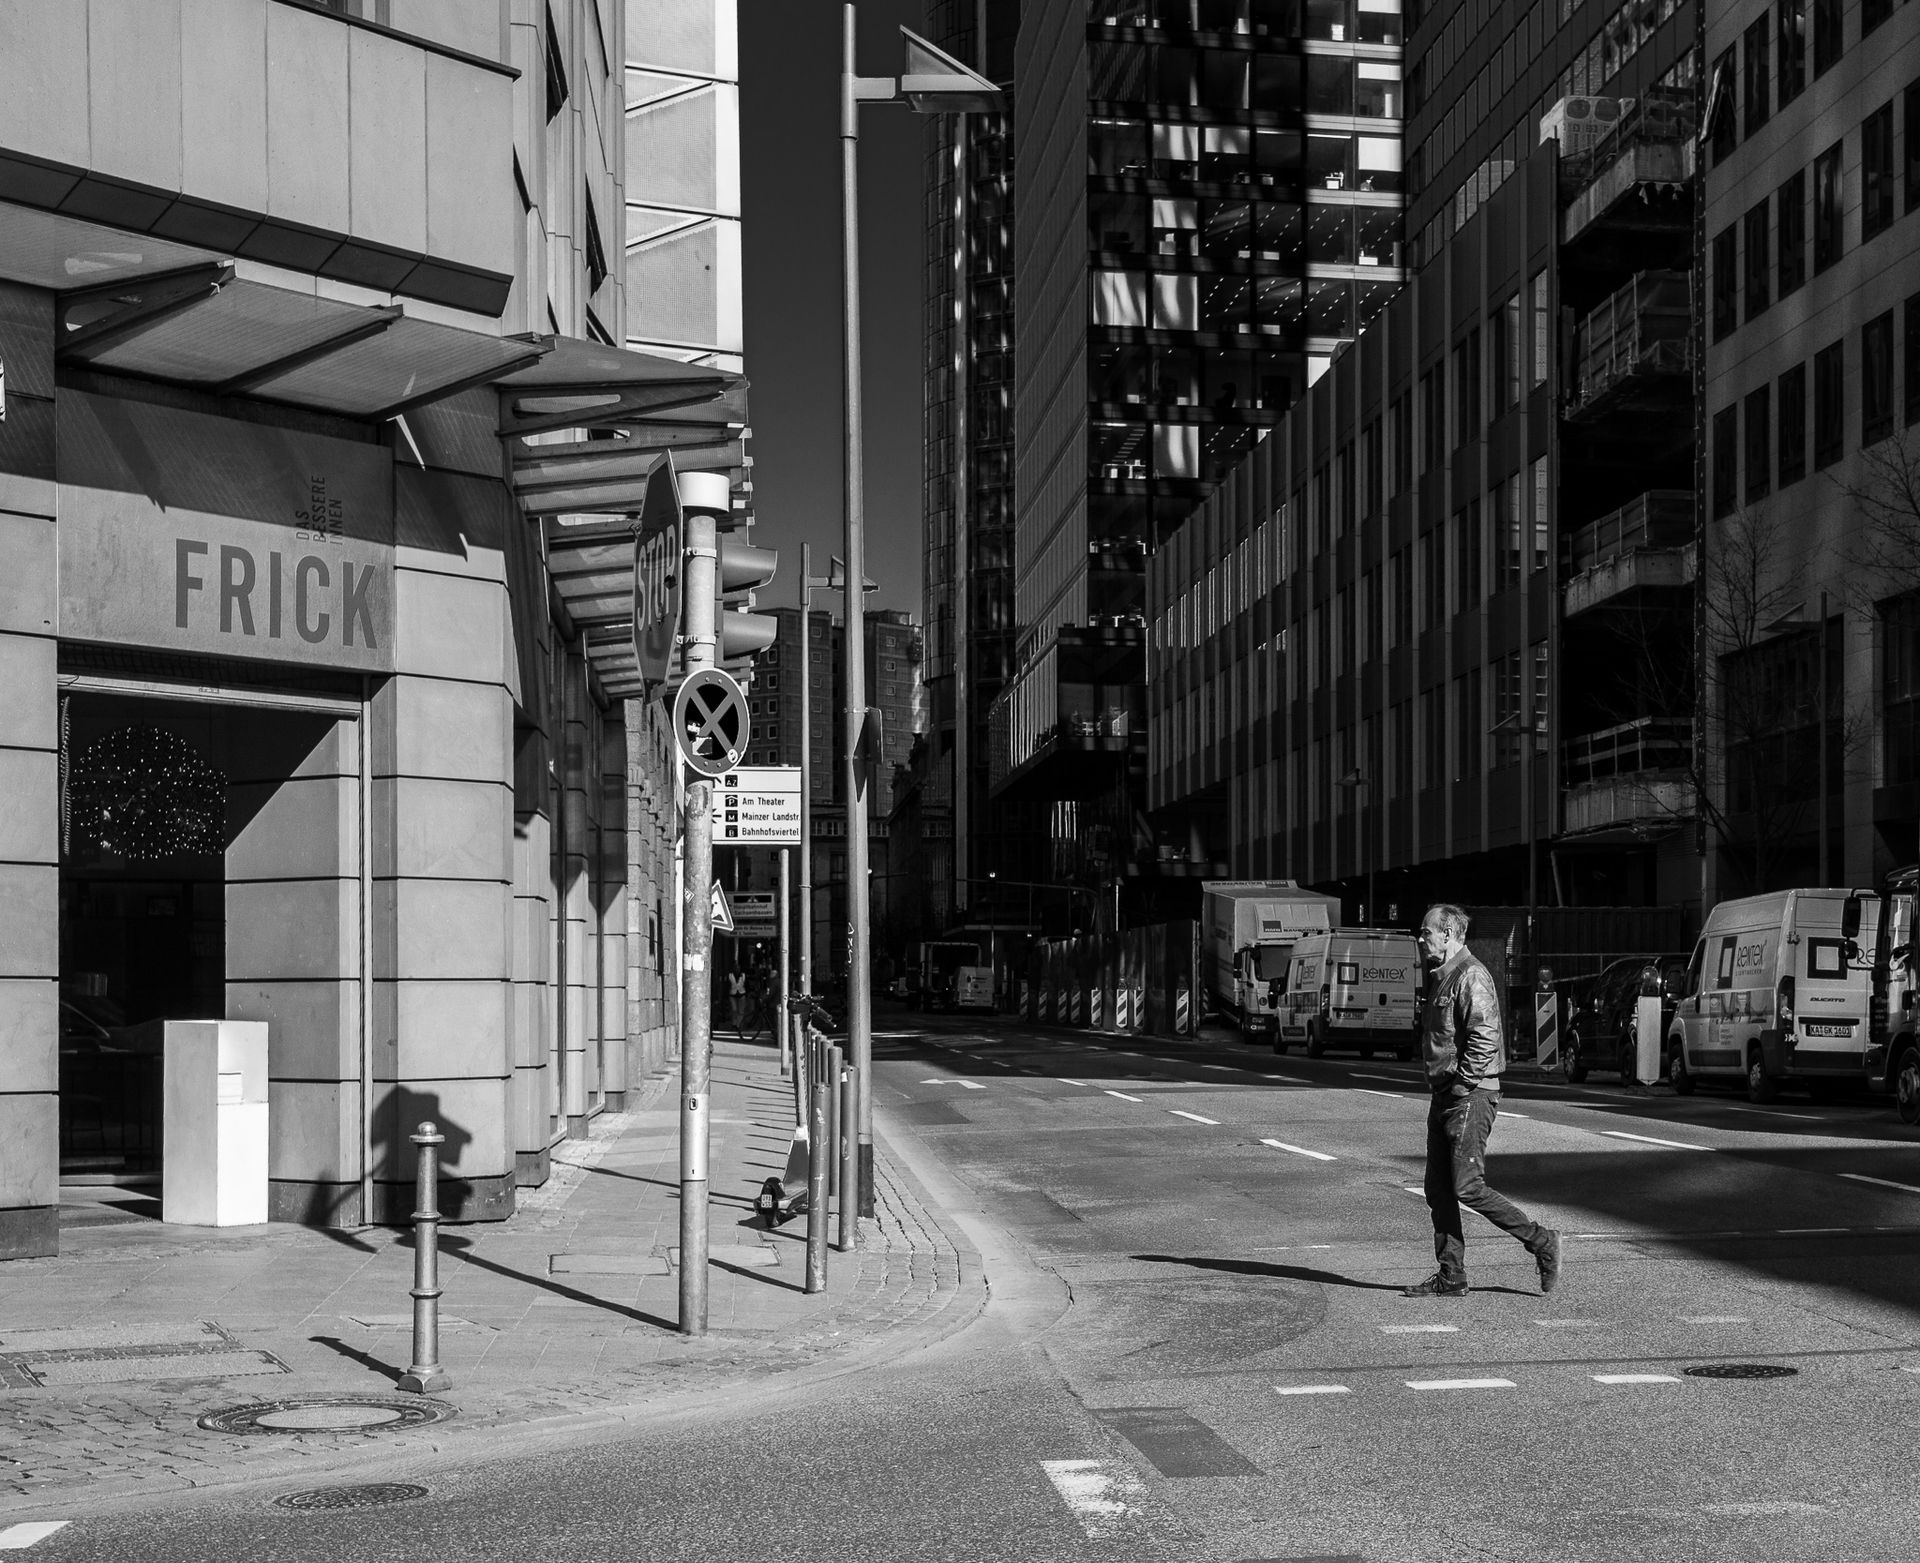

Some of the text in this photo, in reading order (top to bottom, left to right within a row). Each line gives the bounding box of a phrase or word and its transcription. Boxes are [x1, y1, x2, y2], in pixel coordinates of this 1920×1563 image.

[296, 510, 310, 540] DAS
[311, 476, 327, 543] BESSERE
[328, 498, 343, 546] INNEN
[176, 538, 378, 649] FRICK
[637, 524, 676, 631] STOP
[742, 797, 754, 805] Am
[758, 796, 785, 806] Theater
[742, 811, 769, 821] Mainzer
[741, 827, 799, 837] Bahnhofsviertel
